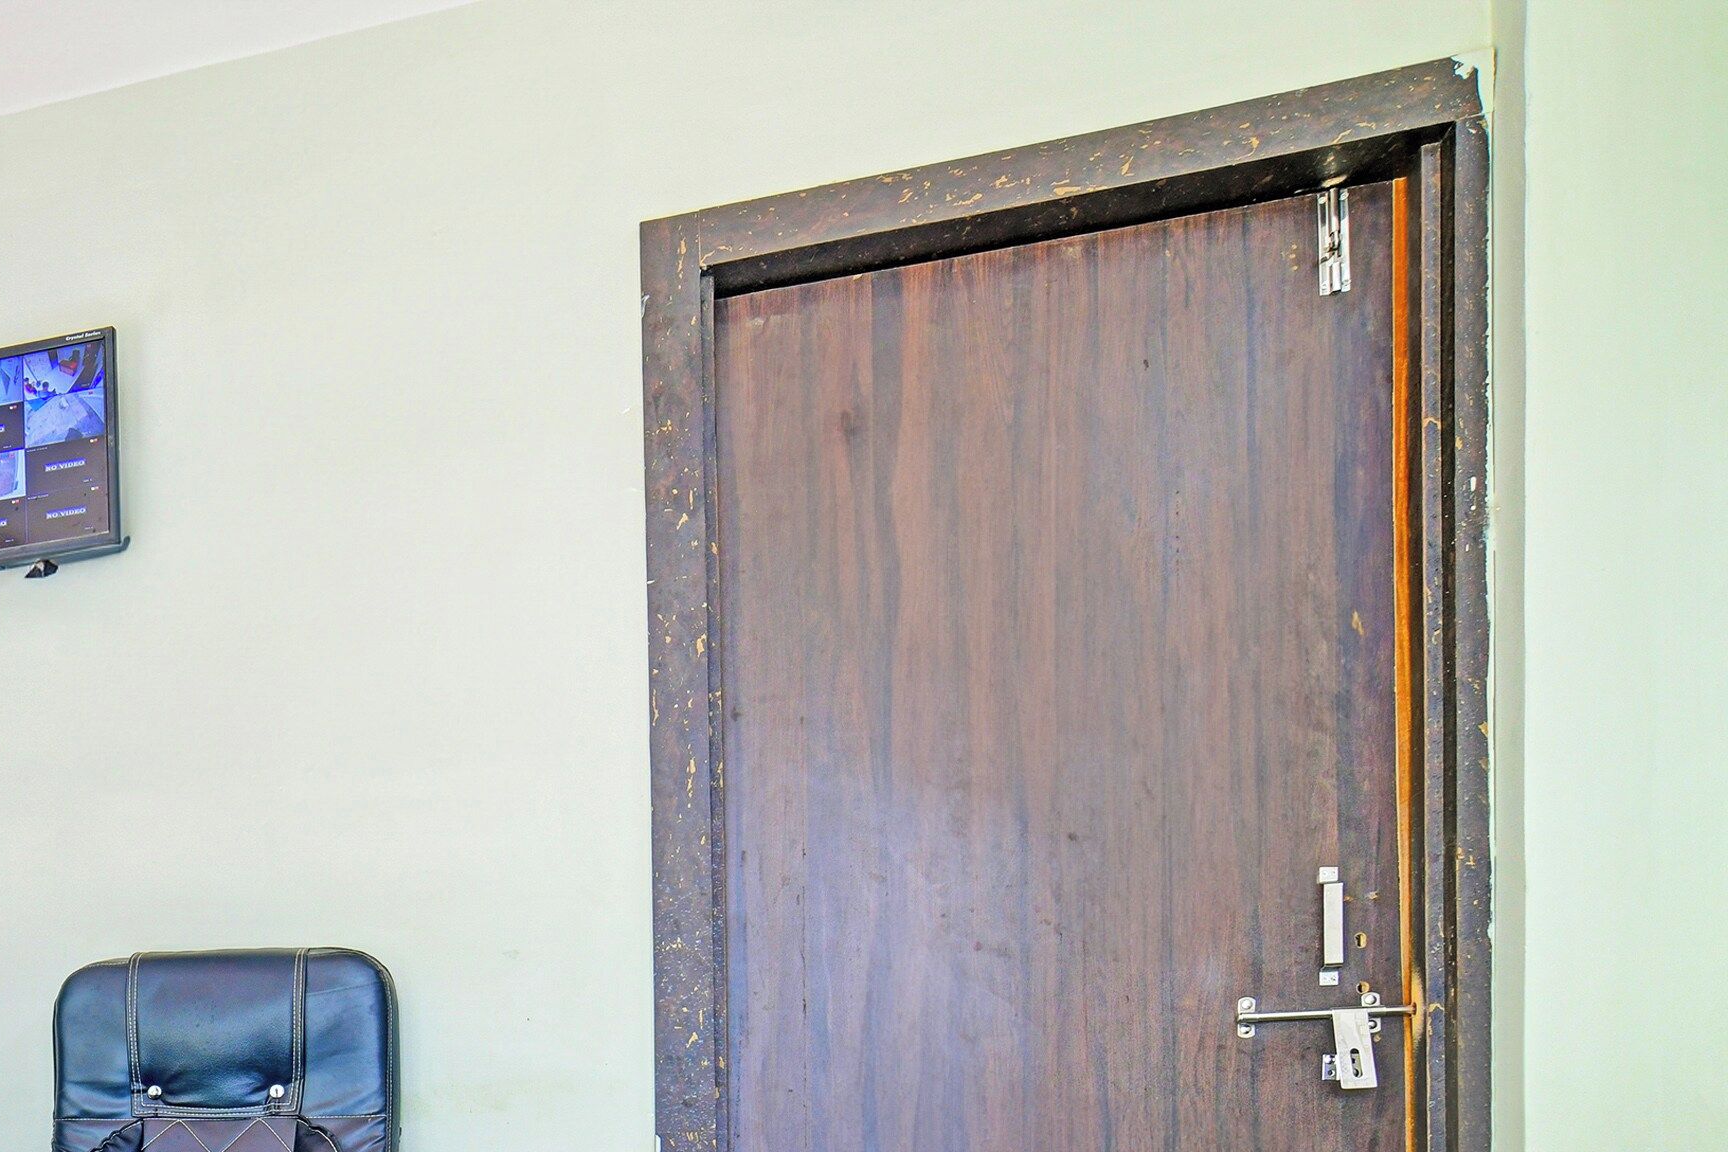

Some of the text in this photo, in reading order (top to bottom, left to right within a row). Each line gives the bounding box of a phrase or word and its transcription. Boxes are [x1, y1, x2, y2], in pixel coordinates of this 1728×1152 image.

[45, 460, 85, 472] NO VIDEO
[60, 508, 86, 517] VIDEO
